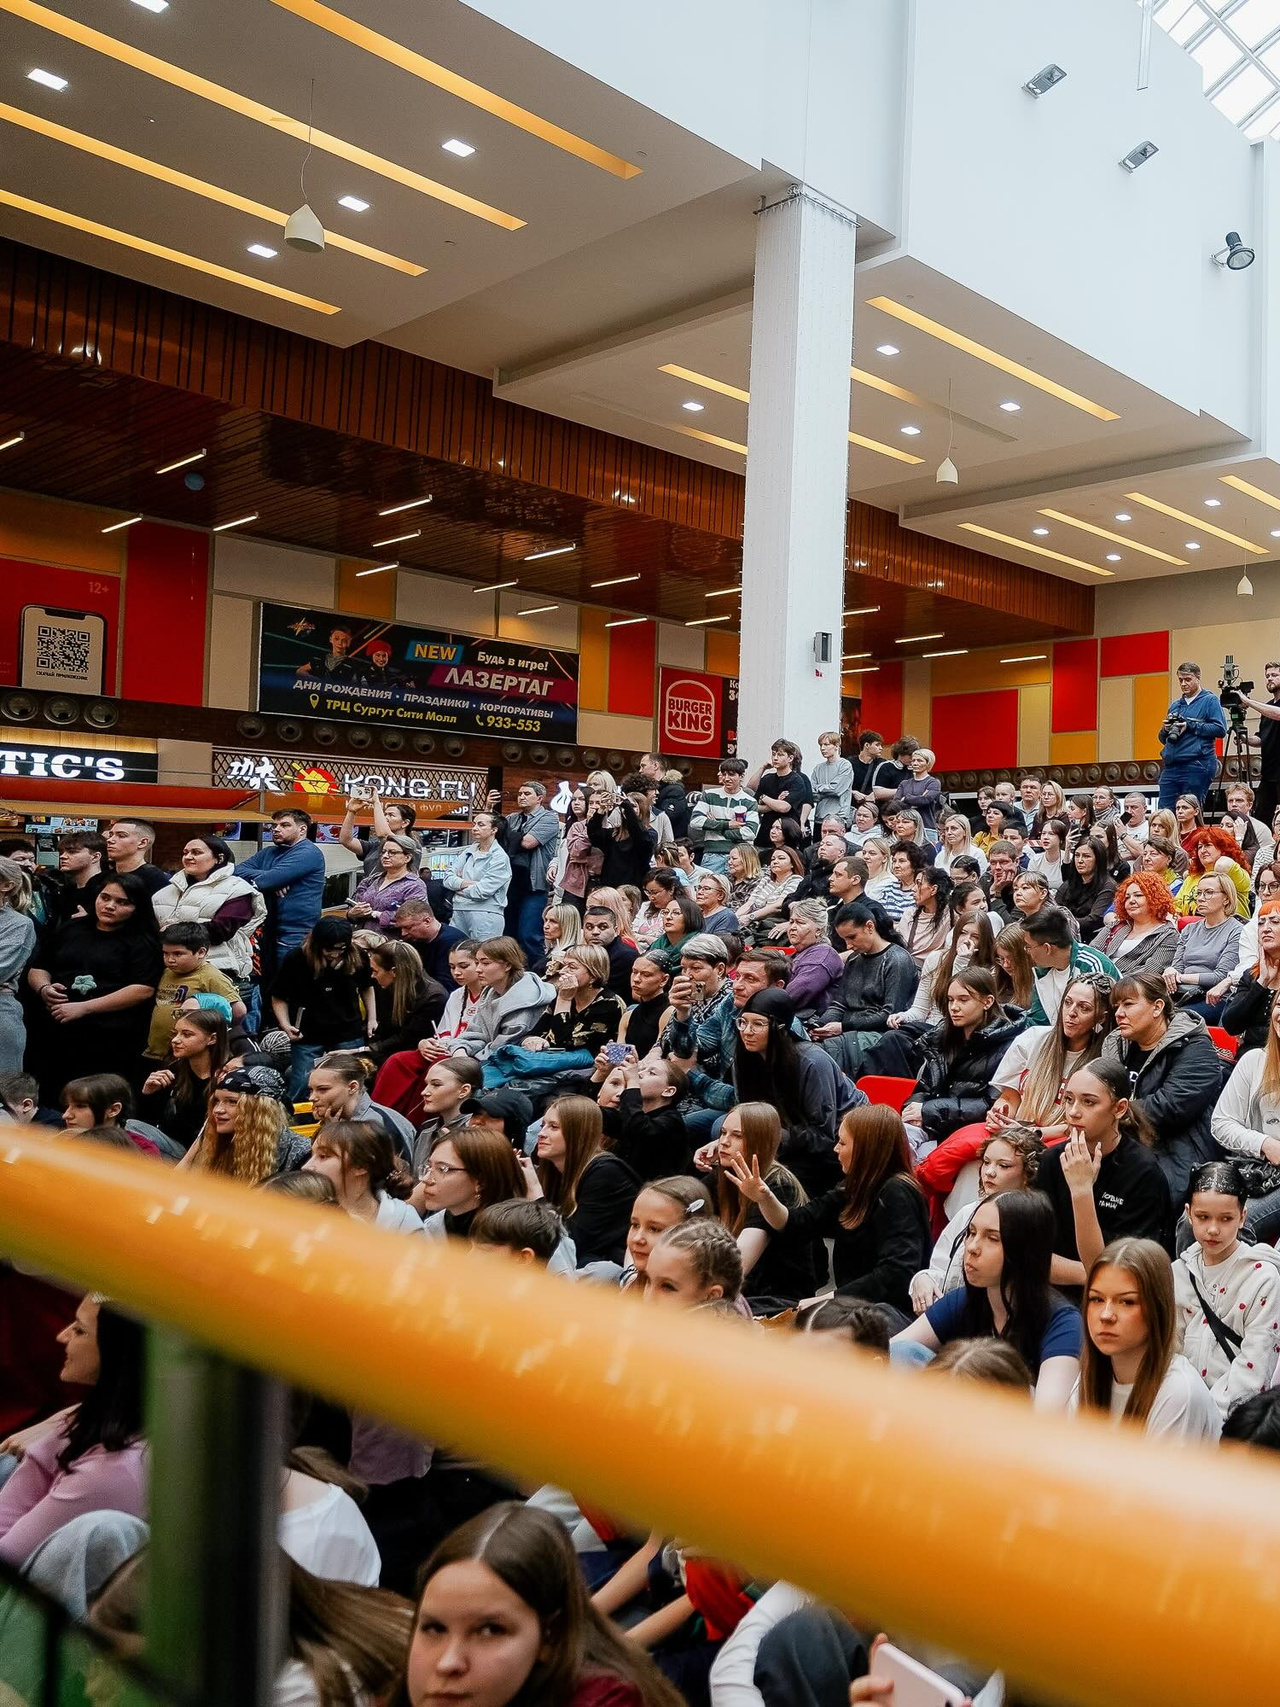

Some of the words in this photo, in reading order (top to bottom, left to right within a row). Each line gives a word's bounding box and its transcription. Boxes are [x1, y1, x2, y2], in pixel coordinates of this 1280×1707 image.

[88, 581, 110, 594] 12+
[413, 643, 458, 661] NEW
[477, 651, 505, 665] Будь
[507, 657, 516, 667] в
[517, 659, 549, 672] игре!
[443, 667, 554, 697] ЛАЗЕРТАГ
[292, 679, 323, 692] ДНИ
[323, 683, 393, 701] РОЖДЕНИЯ
[402, 692, 471, 710] ПРАЗДНИКИ
[479, 702, 554, 720] КОРПОРАТИВЫ
[668, 698, 713, 716] BURGER
[326, 699, 351, 714] ТРЦ
[353, 702, 395, 718] Сургут
[395, 708, 424, 721] Сити
[425, 711, 458, 725] Молл
[667, 710, 713, 732] KING
[486, 715, 542, 733] 933-553
[0, 749, 125, 782] TIC'S
[344, 772, 432, 798] KONG
[440, 780, 476, 801] FU
